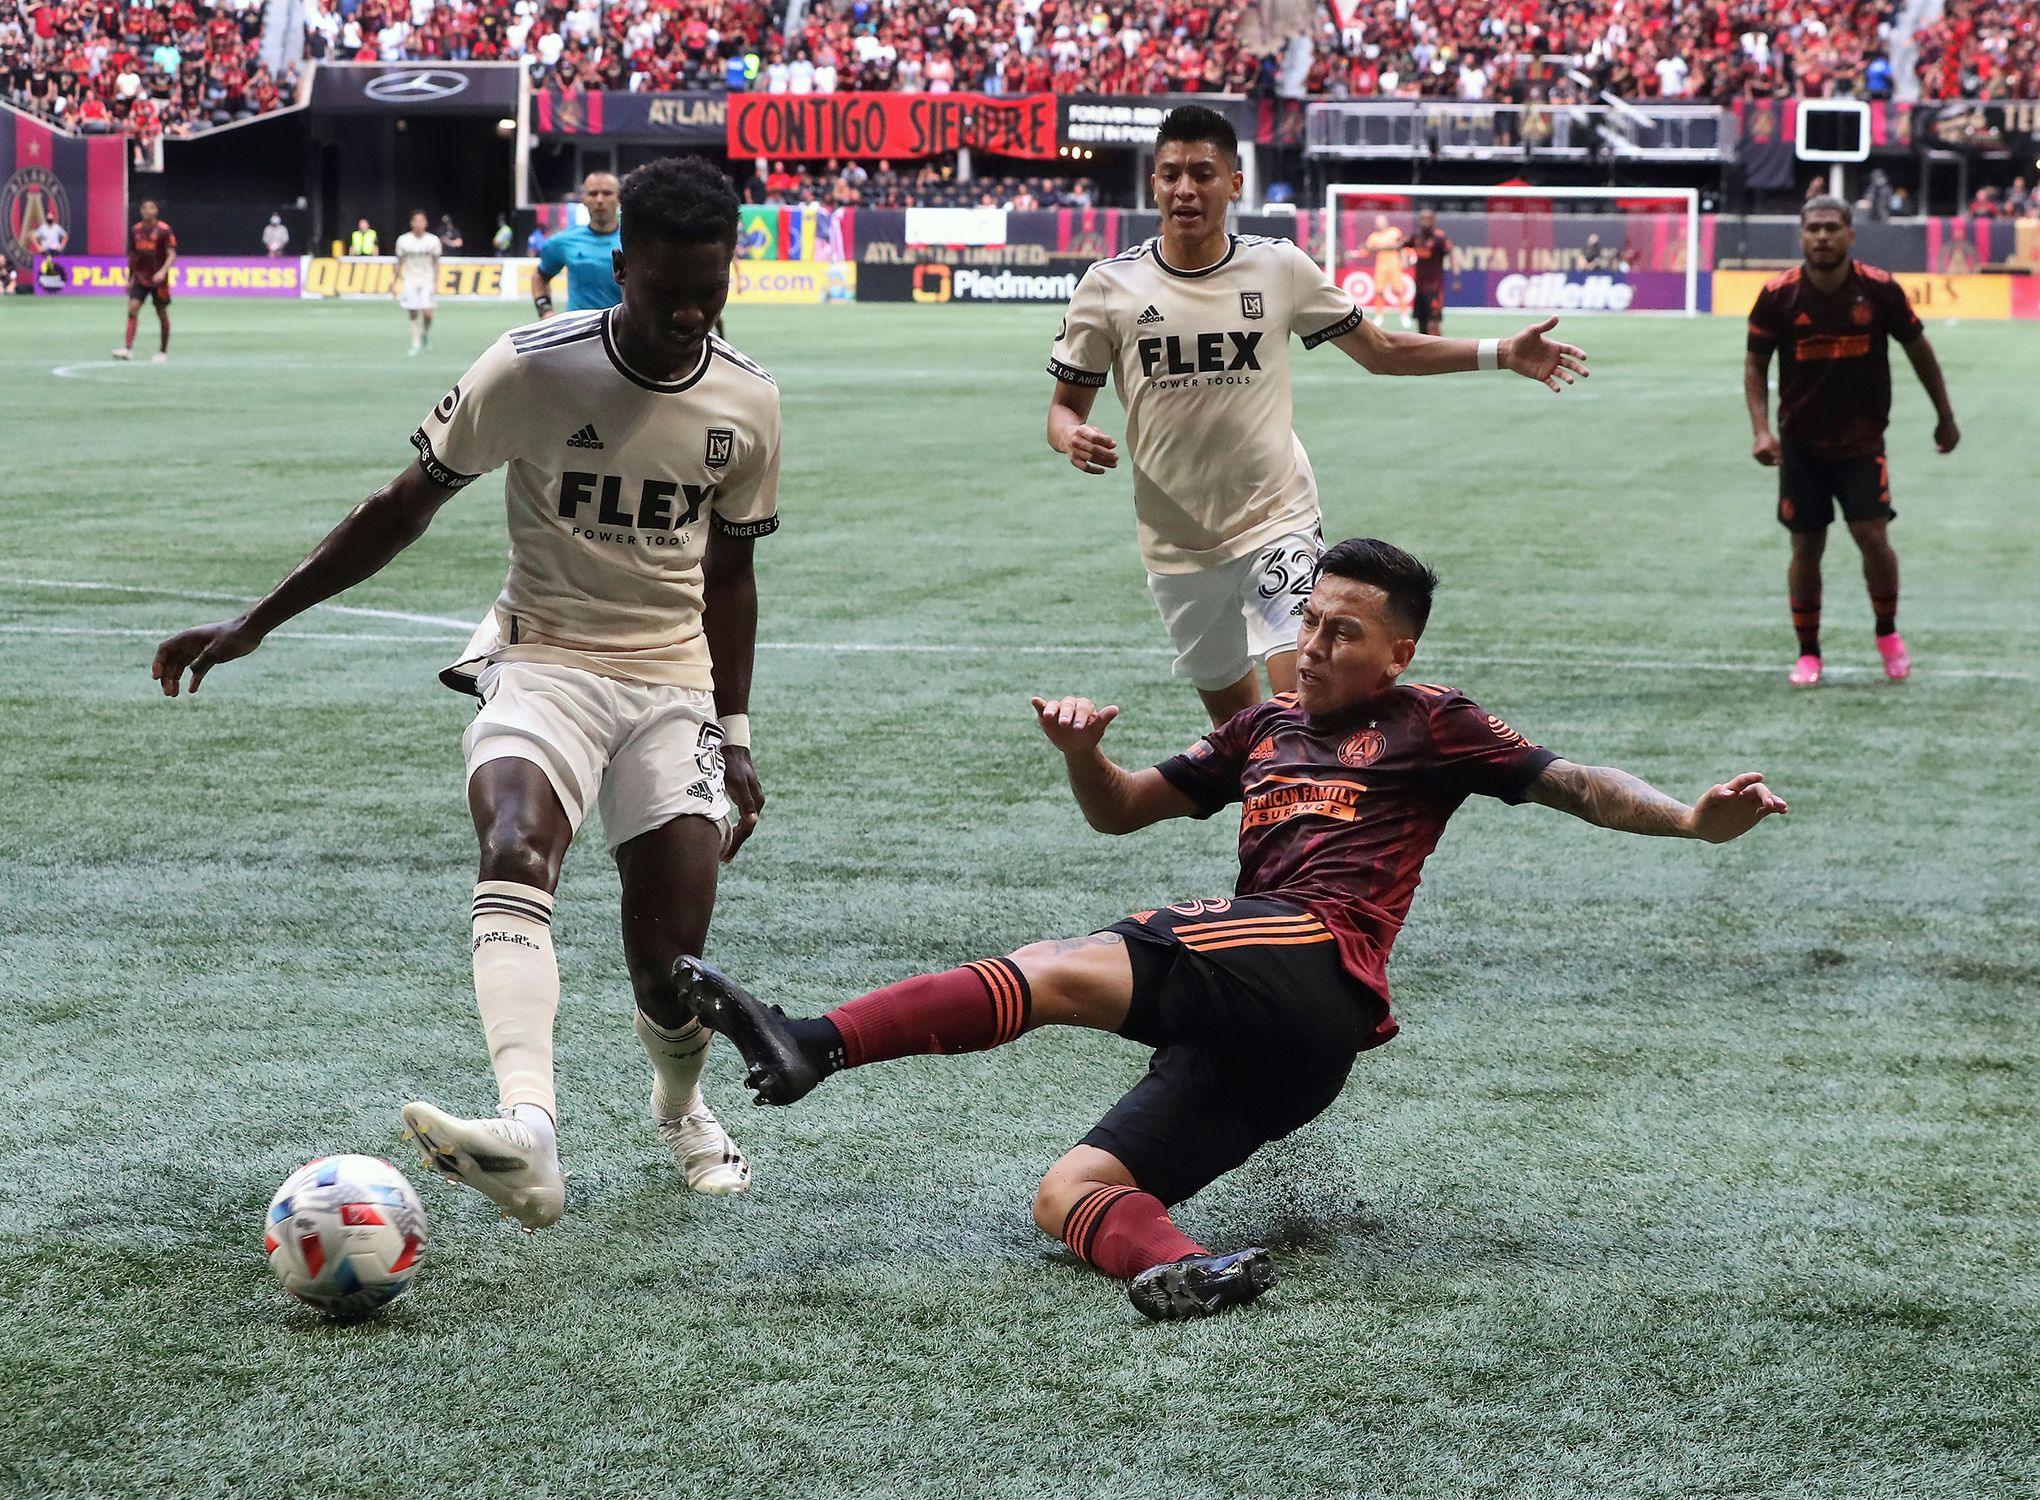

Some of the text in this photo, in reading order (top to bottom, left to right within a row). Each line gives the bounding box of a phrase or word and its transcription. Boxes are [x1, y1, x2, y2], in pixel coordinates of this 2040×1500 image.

[648, 98, 729, 126] ATLAN
[737, 100, 1047, 154] CONTIGO SIEMPRE
[72, 267, 297, 288] PLAT FITNESS
[953, 270, 1077, 299] Piedmont
[1496, 273, 1634, 310] Gillette
[1136, 316, 1164, 325] adidas
[1138, 332, 1264, 377] FLEX
[1058, 368, 1075, 380] LOS
[1151, 376, 1251, 389] POWER TOOLS
[567, 439, 604, 450] adidas
[426, 461, 448, 483] LOS
[558, 472, 715, 532] FLEX
[572, 527, 690, 546] POWER TOOLS
[723, 522, 771, 537] ANGELES
[686, 788, 713, 804] adida
[1302, 786, 1360, 807] FAMILY
[1247, 803, 1342, 823] NSURANCE
